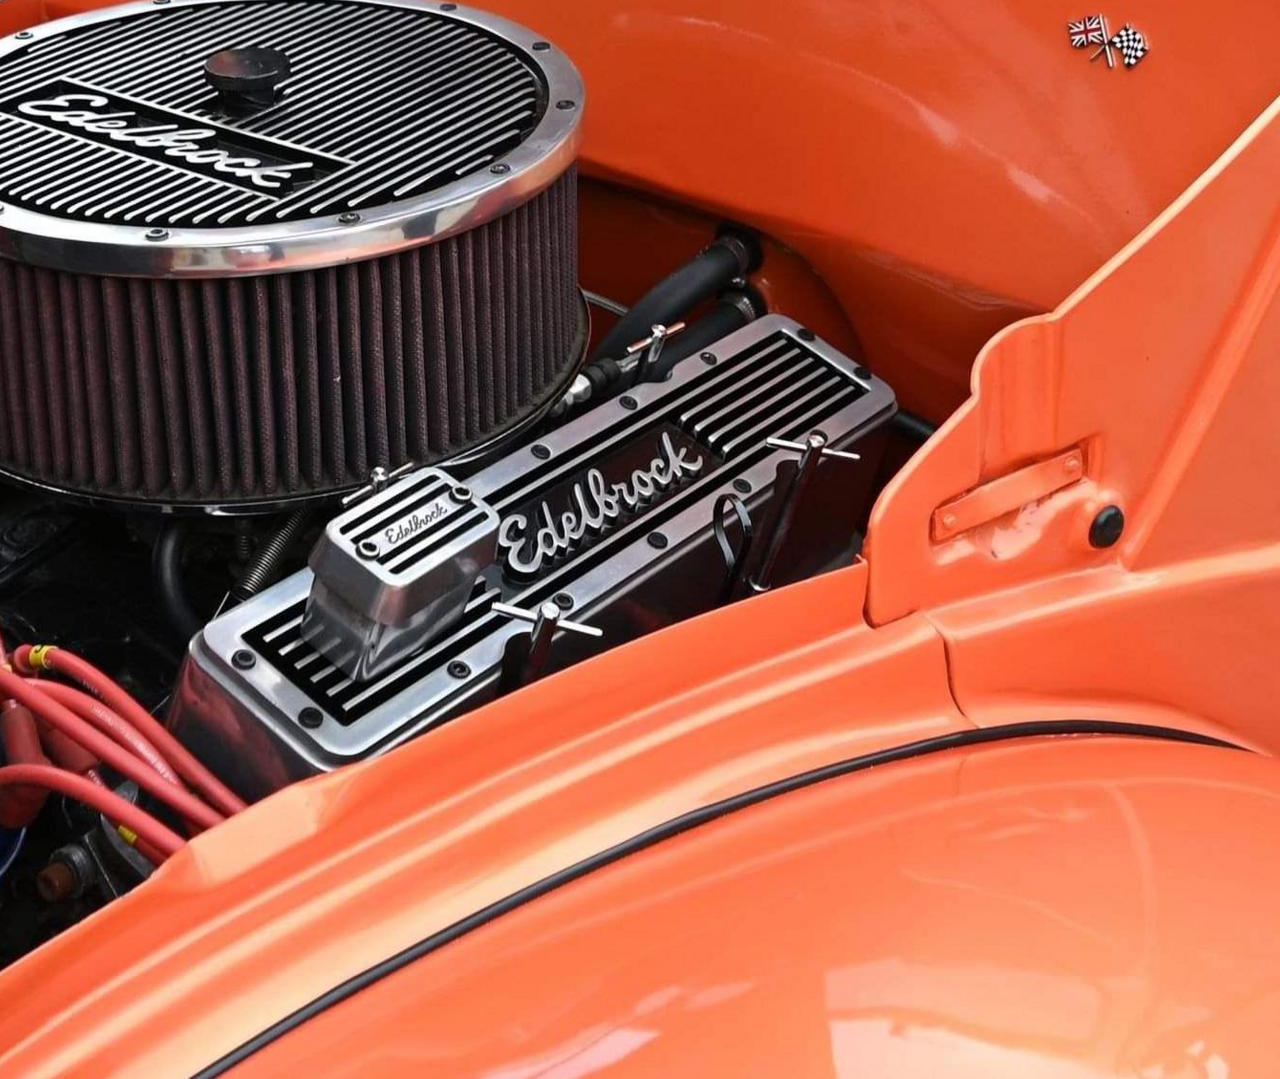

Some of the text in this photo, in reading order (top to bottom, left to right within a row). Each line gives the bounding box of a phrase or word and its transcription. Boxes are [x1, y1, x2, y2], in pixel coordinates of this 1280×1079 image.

[18, 94, 313, 188] Edelbrock
[385, 503, 448, 544] Edelbrock
[498, 431, 703, 573] Edelbrock
